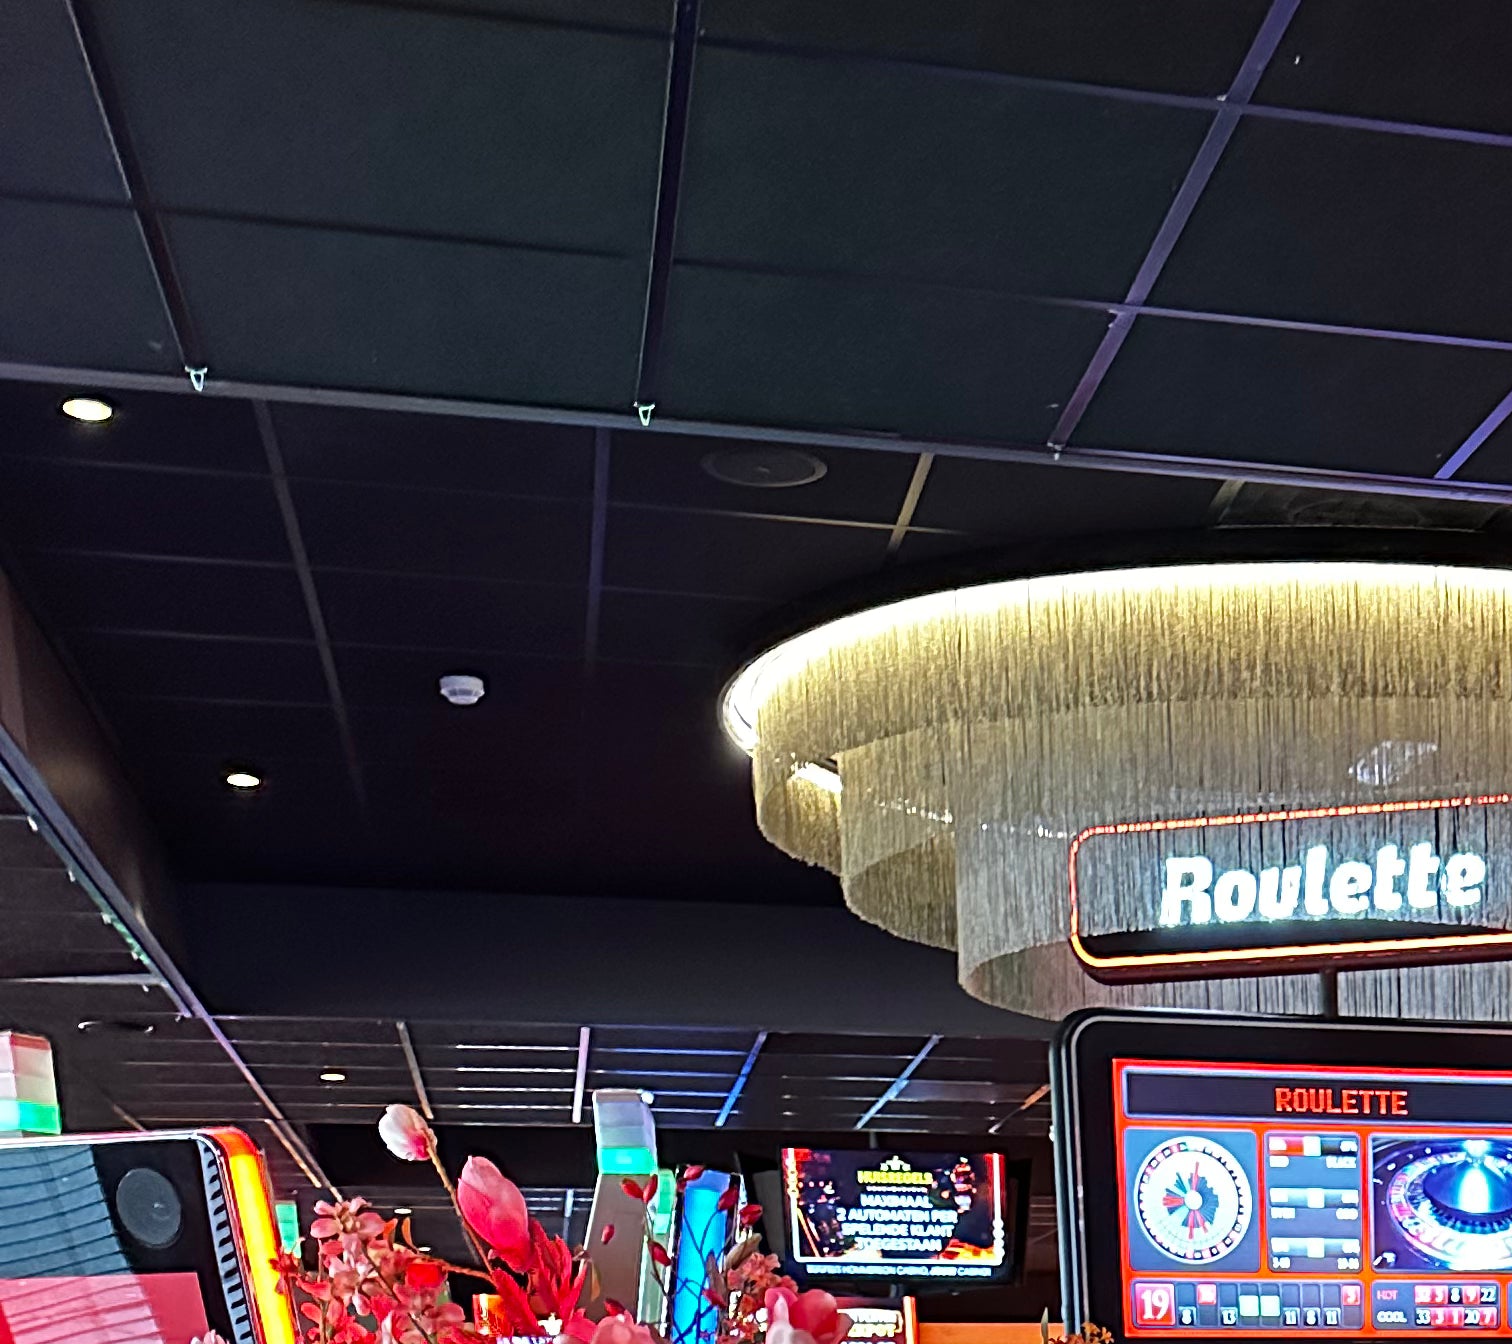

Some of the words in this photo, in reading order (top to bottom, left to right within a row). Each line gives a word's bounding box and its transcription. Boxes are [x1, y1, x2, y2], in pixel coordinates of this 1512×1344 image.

[1160, 842, 1486, 926] Roulette
[1275, 1087, 1409, 1116] ROULETTE
[836, 1207, 847, 1222] 2
[848, 1208, 930, 1223] AUTOMATEN
[1141, 1289, 1170, 1320] 19
